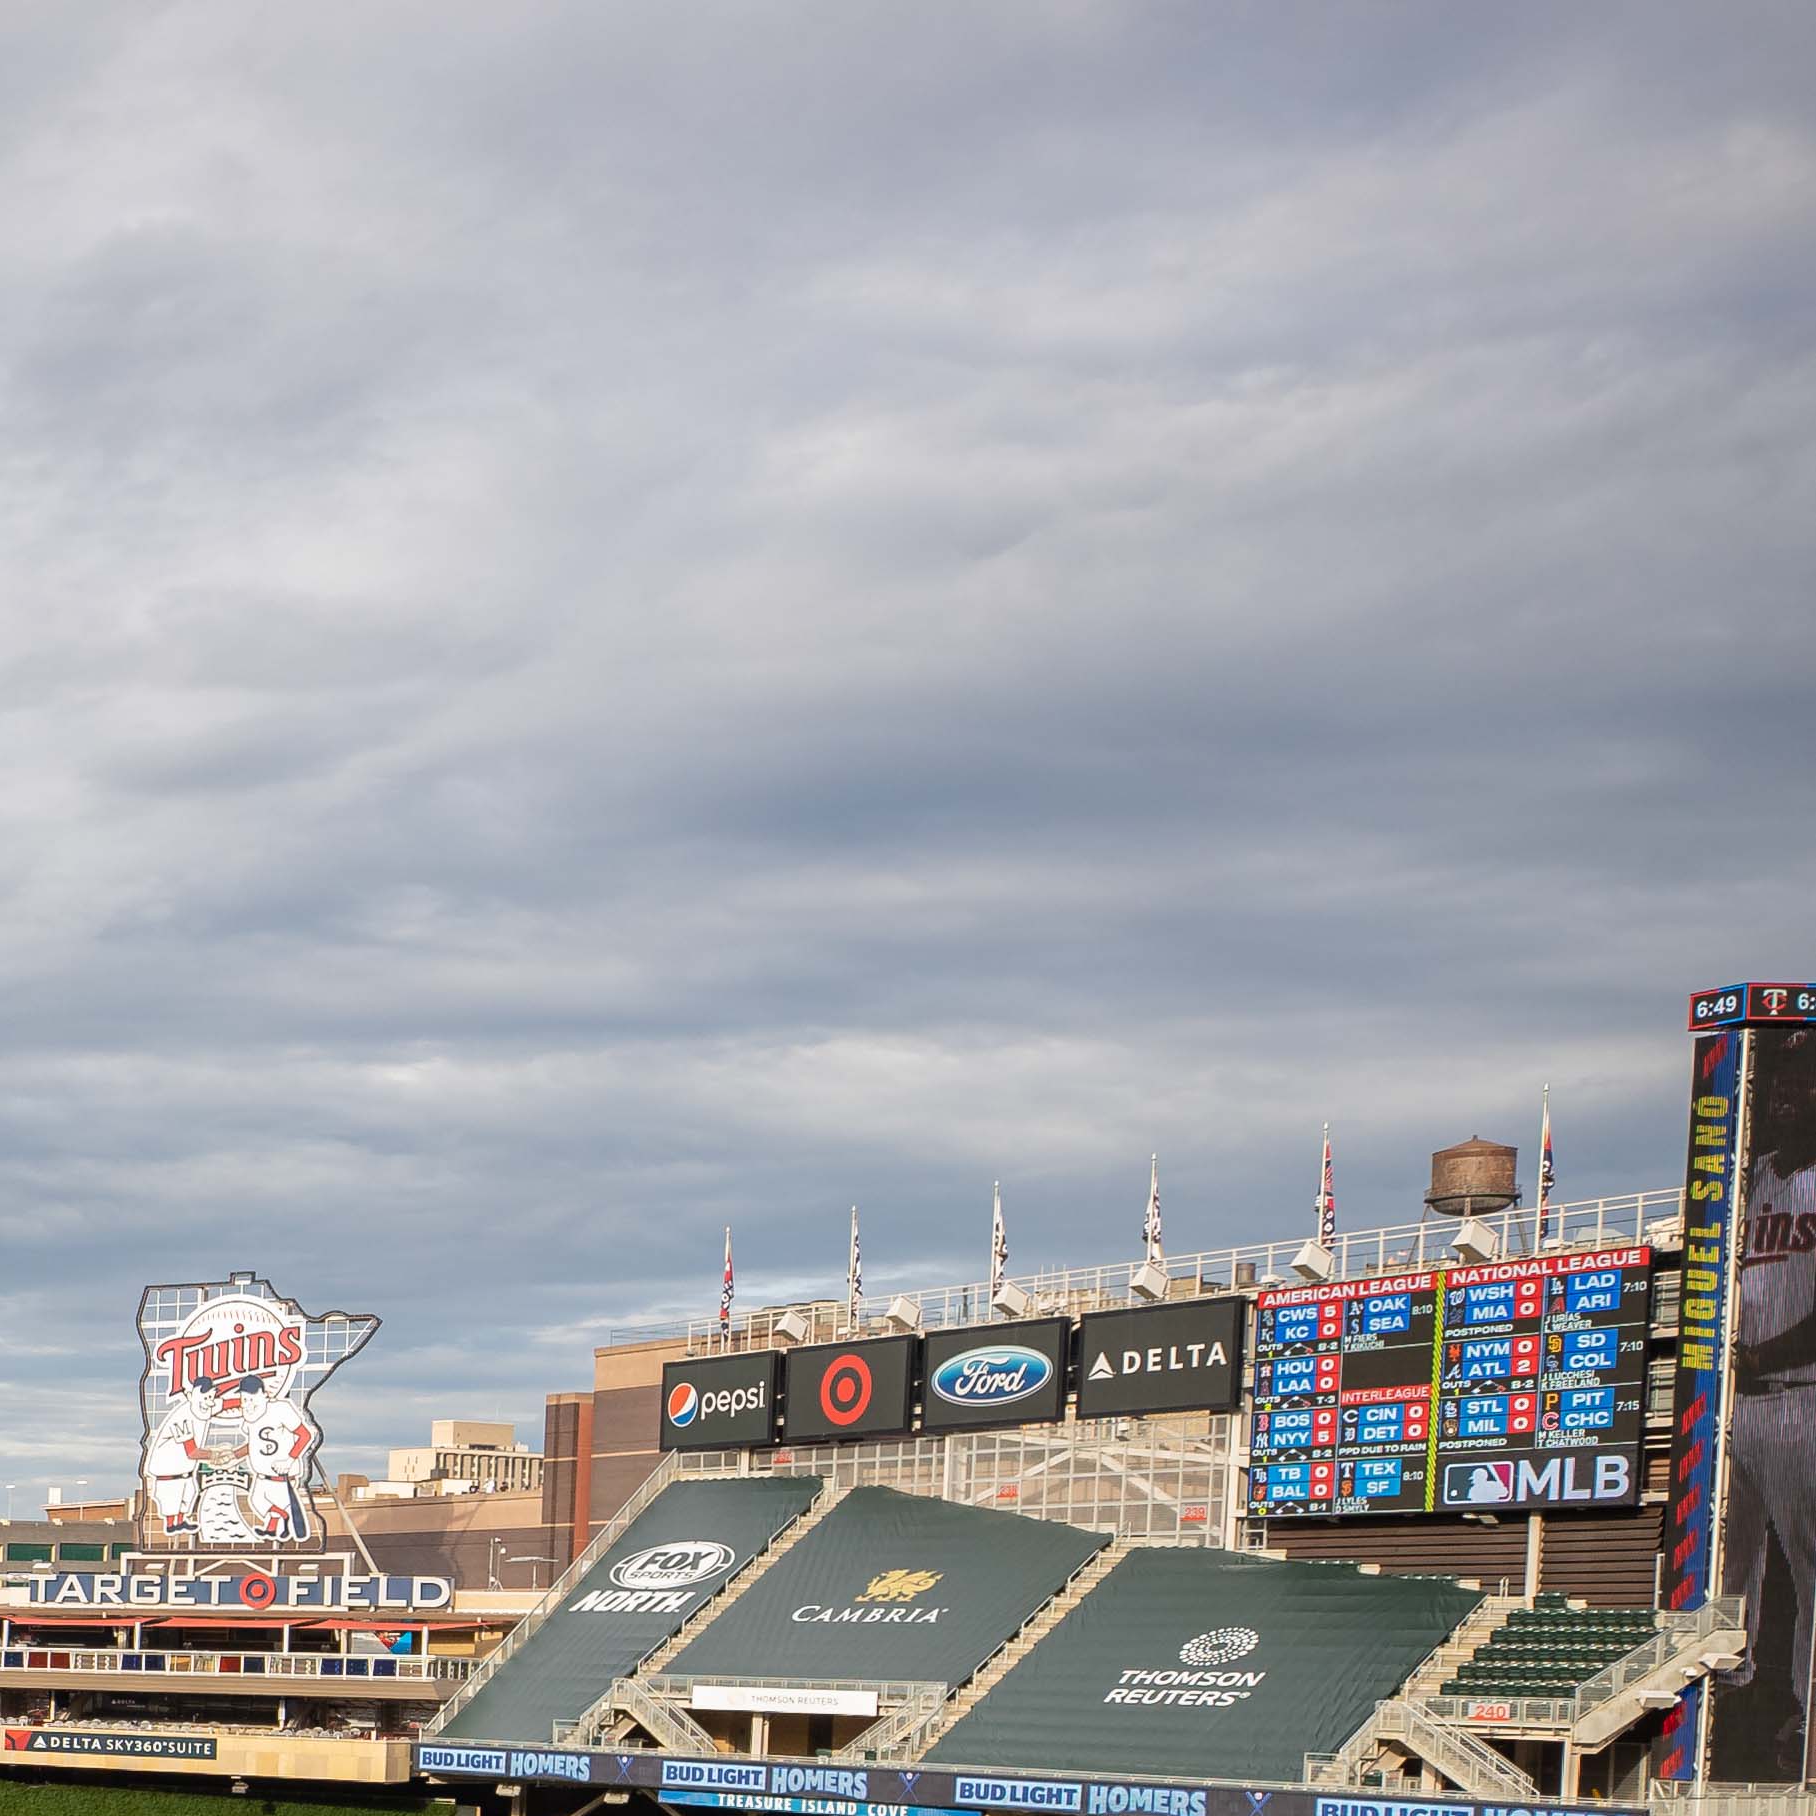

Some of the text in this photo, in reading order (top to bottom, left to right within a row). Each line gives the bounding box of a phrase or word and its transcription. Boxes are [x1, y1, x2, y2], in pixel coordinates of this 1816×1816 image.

[1697, 994, 1737, 1018] 6:49
[1692, 1095, 1728, 1201] SANÓ
[1451, 1250, 1641, 1284] NATIONAL LEAGUE
[1576, 1273, 1615, 1289] LAD
[1264, 1275, 1431, 1307] AMERICAN LEAGUE
[1469, 1283, 1513, 1301] WSH
[1682, 1222, 1721, 1371] MIGUEL
[1369, 1296, 1407, 1312] OAK
[1473, 1304, 1507, 1319] MIA
[1278, 1305, 1318, 1322] CWS
[1121, 1340, 1228, 1374] DELTA
[1467, 1341, 1510, 1358] NYM
[156, 1322, 304, 1399] Twins
[1277, 1358, 1313, 1374] HOU
[1468, 1361, 1505, 1377] ATL
[956, 1357, 1027, 1394] Ford
[700, 1380, 765, 1421] pepsi
[1341, 1385, 1429, 1403] INTERLEAGUE
[1572, 1391, 1604, 1407] PIT
[1366, 1405, 1398, 1421] CIN
[1467, 1398, 1503, 1413] STL
[1275, 1413, 1310, 1427] BOS
[1274, 1431, 1309, 1446] NYY
[1361, 1461, 1396, 1476] TEX
[1518, 1454, 1630, 1502] MLB
[646, 1545, 717, 1573] FOX
[629, 1569, 694, 1581] SPORTS
[36, 1574, 452, 1609] TARGET FIELD
[792, 1605, 941, 1625] CAMBRIA
[1120, 1668, 1265, 1688] THOMSON
[752, 1695, 839, 1707] THOMSON REUTERS
[1103, 1688, 1240, 1709] REUTERS
[1474, 1704, 1507, 1721] 240
[666, 1765, 867, 1800] BUD LIGHT HOMERS
[718, 1793, 792, 1811] TREASURE
[800, 1798, 859, 1815] ISLAND
